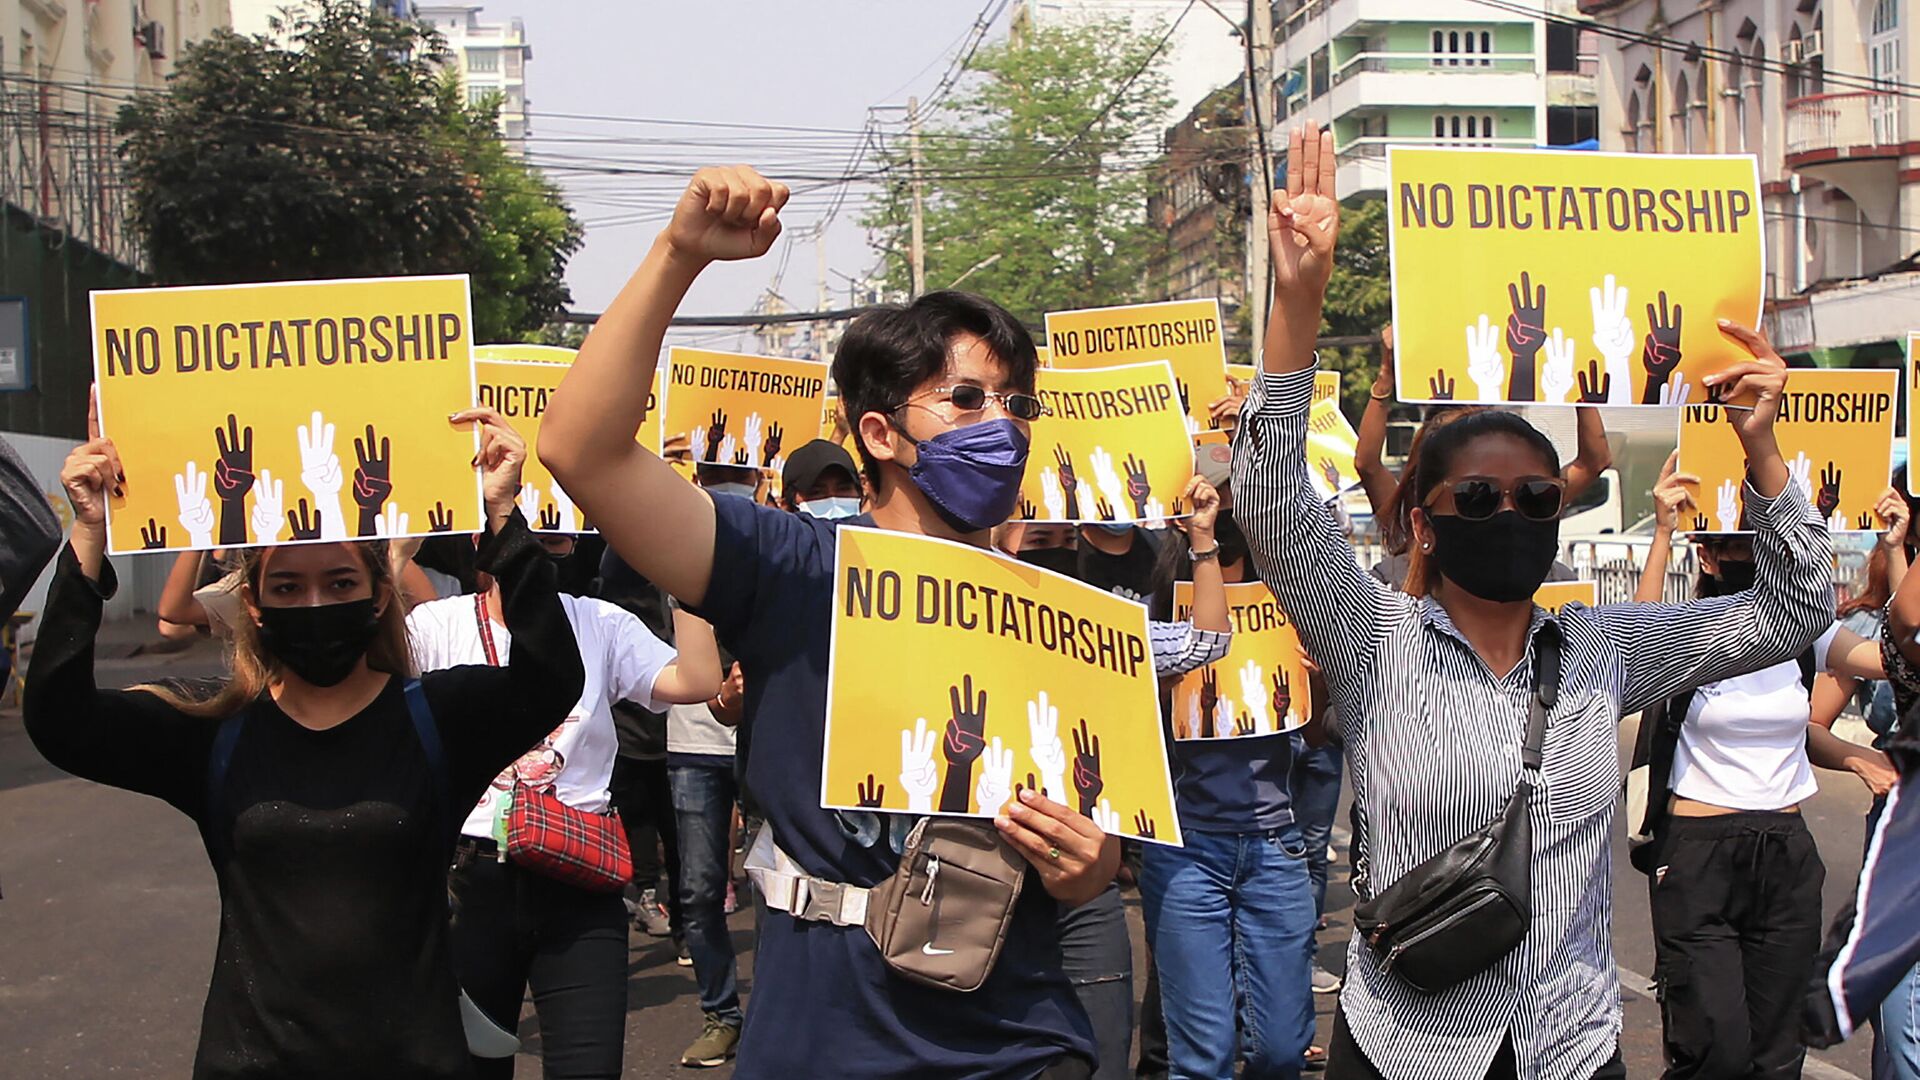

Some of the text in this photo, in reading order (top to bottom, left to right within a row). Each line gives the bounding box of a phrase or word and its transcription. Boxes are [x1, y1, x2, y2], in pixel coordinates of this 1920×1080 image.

[1400, 183, 1750, 233] NO DICTATORSHIP
[105, 313, 461, 376] NO DICTATORSHIP
[1053, 318, 1216, 357] NO DICTATORSHIP
[672, 363, 823, 399] NO DICTATORSHIP
[1038, 383, 1171, 420] CTATORSHIP
[1727, 392, 1890, 423] ATORSHIP
[846, 566, 1145, 678] NO DICTATORSHIP
